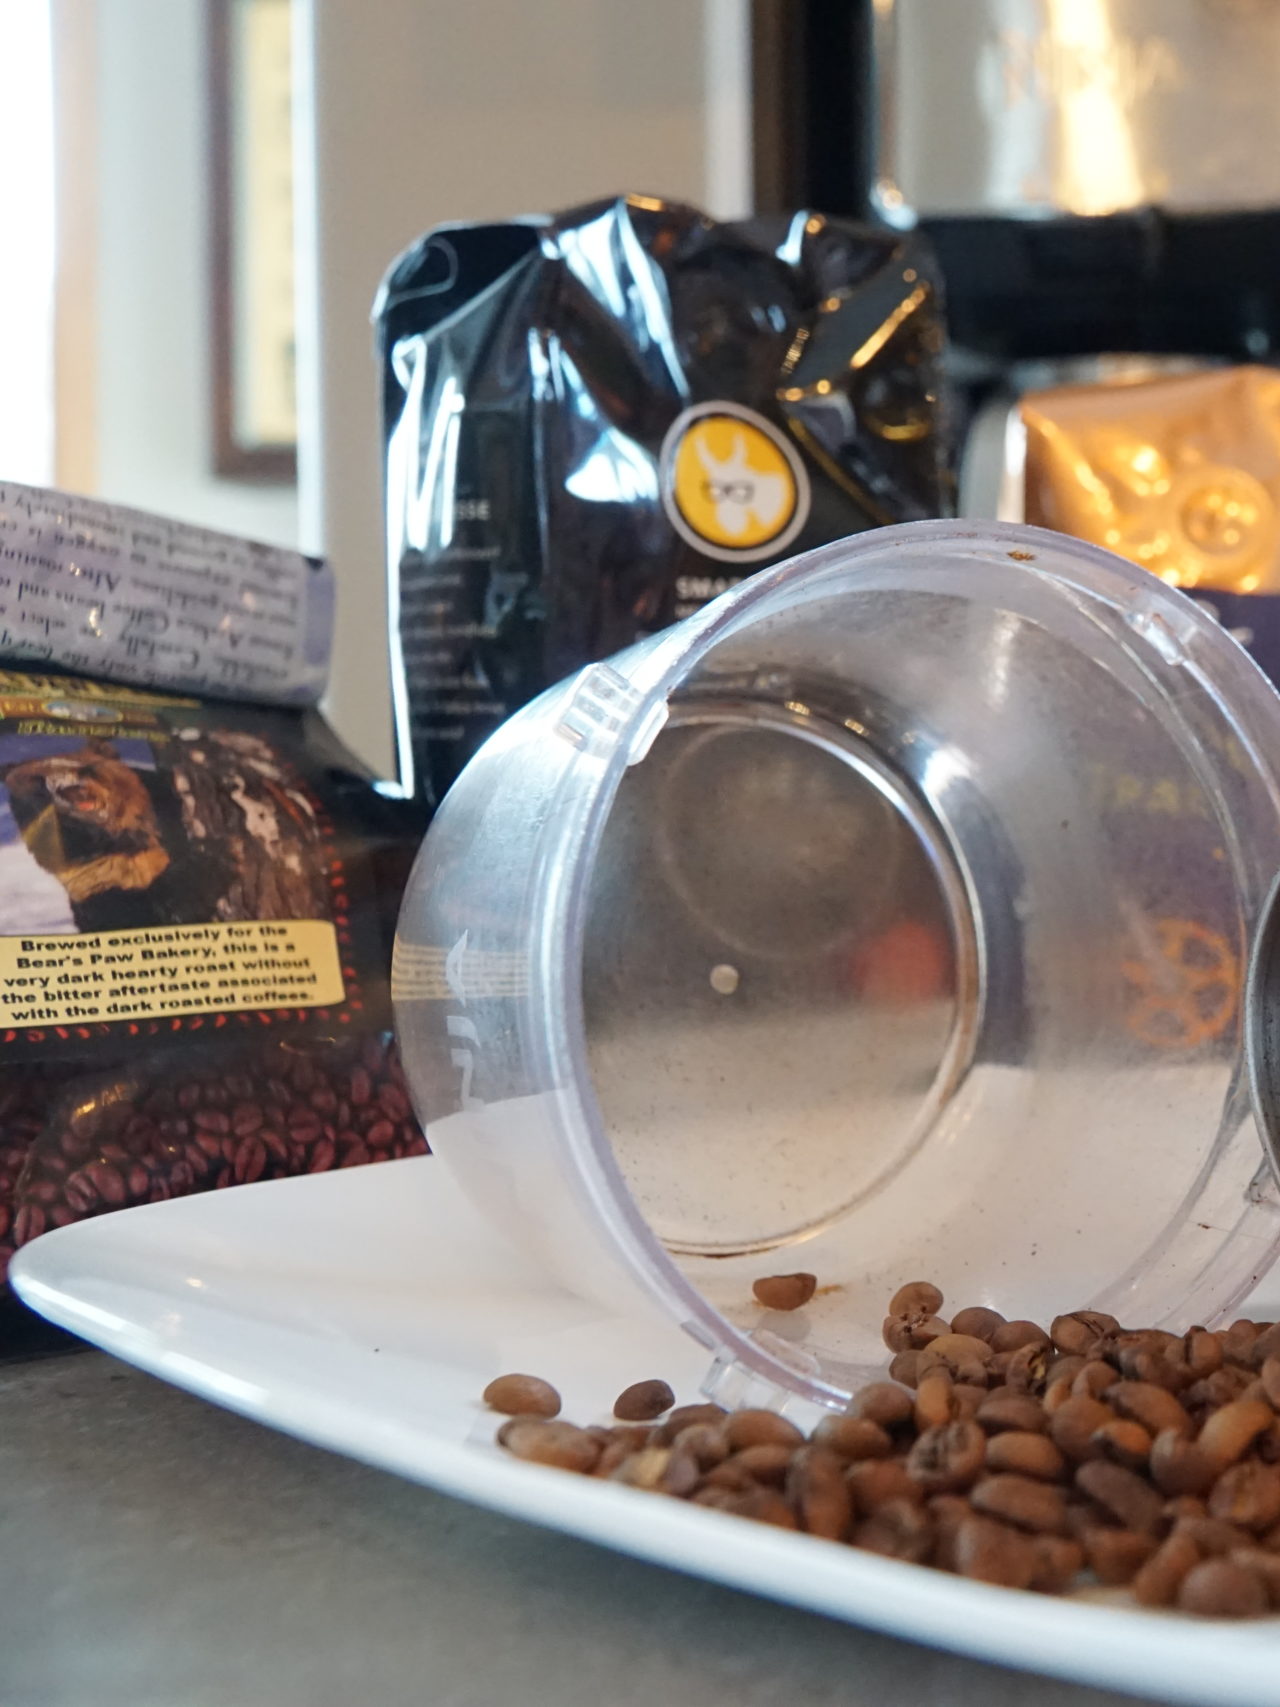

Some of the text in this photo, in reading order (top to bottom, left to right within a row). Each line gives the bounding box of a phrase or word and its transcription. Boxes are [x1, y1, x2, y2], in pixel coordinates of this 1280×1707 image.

[20, 611, 66, 633] select
[21, 926, 288, 952] Brewed exclusively for the
[16, 943, 296, 969] Bear's Paw Bakery, this is a
[4, 958, 311, 988] very dark hearty roast without
[1, 974, 317, 1004] the bitter aftertaste associated
[11, 991, 315, 1021] with the dark roasted coffees.
